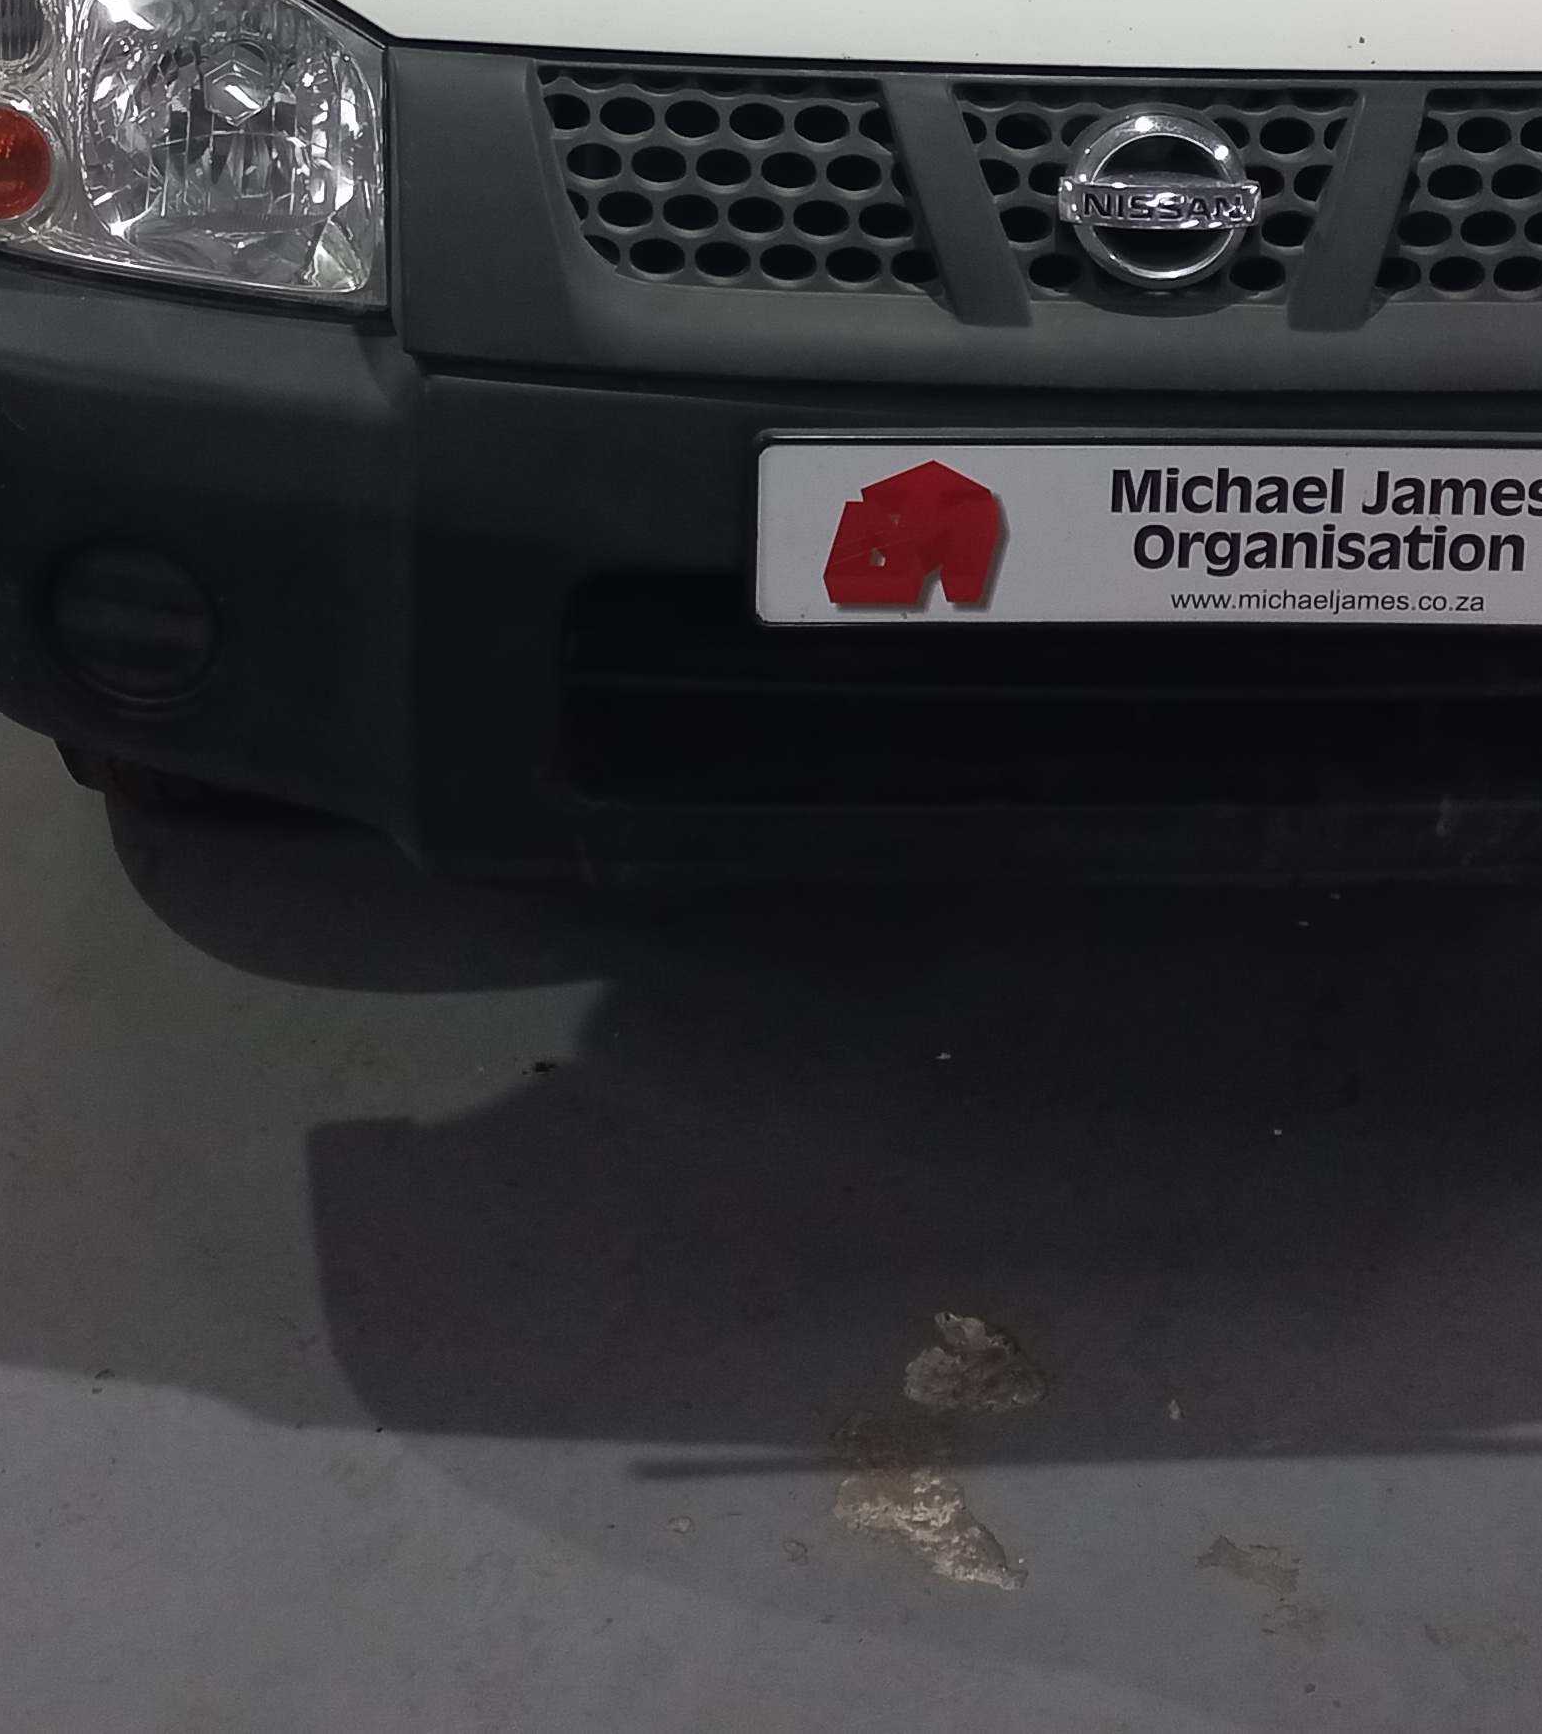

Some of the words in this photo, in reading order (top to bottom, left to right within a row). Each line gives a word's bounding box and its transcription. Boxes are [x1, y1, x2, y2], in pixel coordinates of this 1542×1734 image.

[1083, 192, 1246, 221] NISSAN
[1110, 467, 1345, 515] Michael
[1133, 524, 1526, 575] Organisation
[1170, 589, 1484, 615] www.michaeljames.co.za
